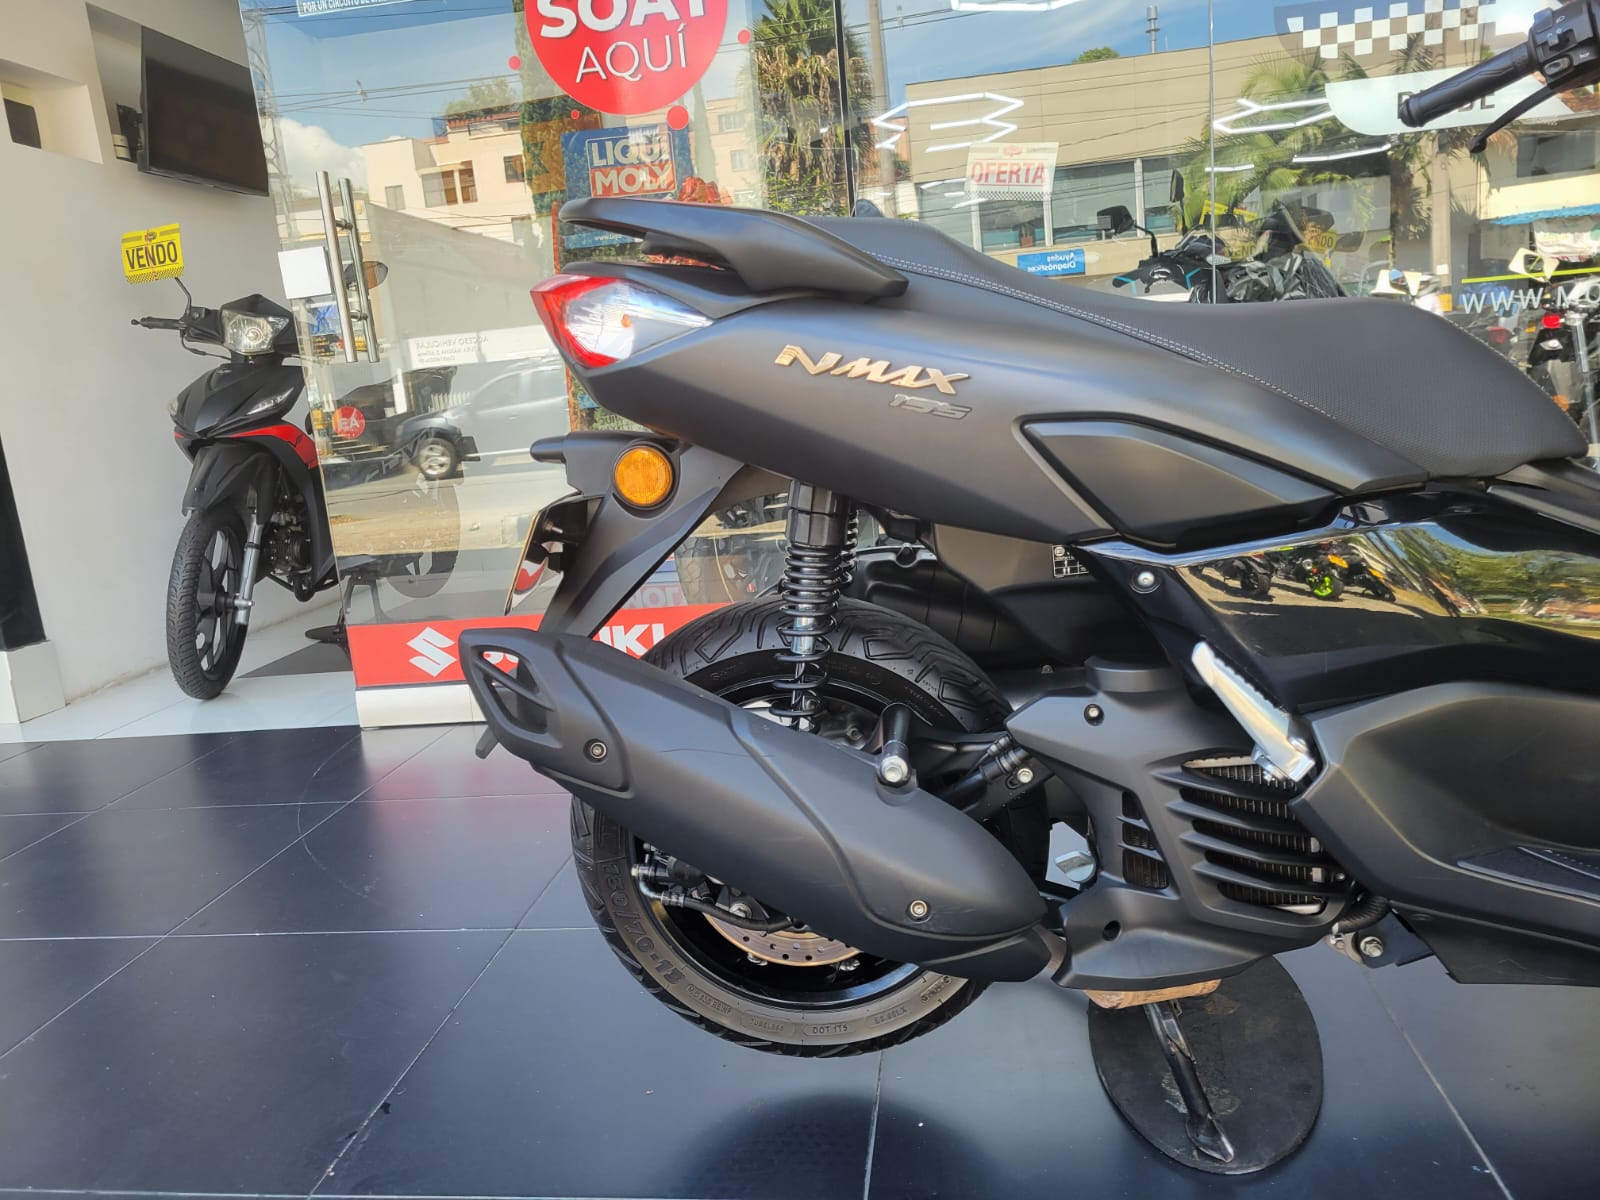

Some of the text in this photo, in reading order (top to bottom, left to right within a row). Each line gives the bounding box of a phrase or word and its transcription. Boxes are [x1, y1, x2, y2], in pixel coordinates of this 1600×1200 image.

[575, 23, 687, 84] AQUÍ
[591, 133, 671, 167] LIQUI
[594, 161, 673, 195] MOLY
[970, 161, 1046, 185] OFERTA
[125, 240, 178, 270] VENDO
[774, 344, 971, 395] NMAX
[812, 1026, 831, 1035] DOT
